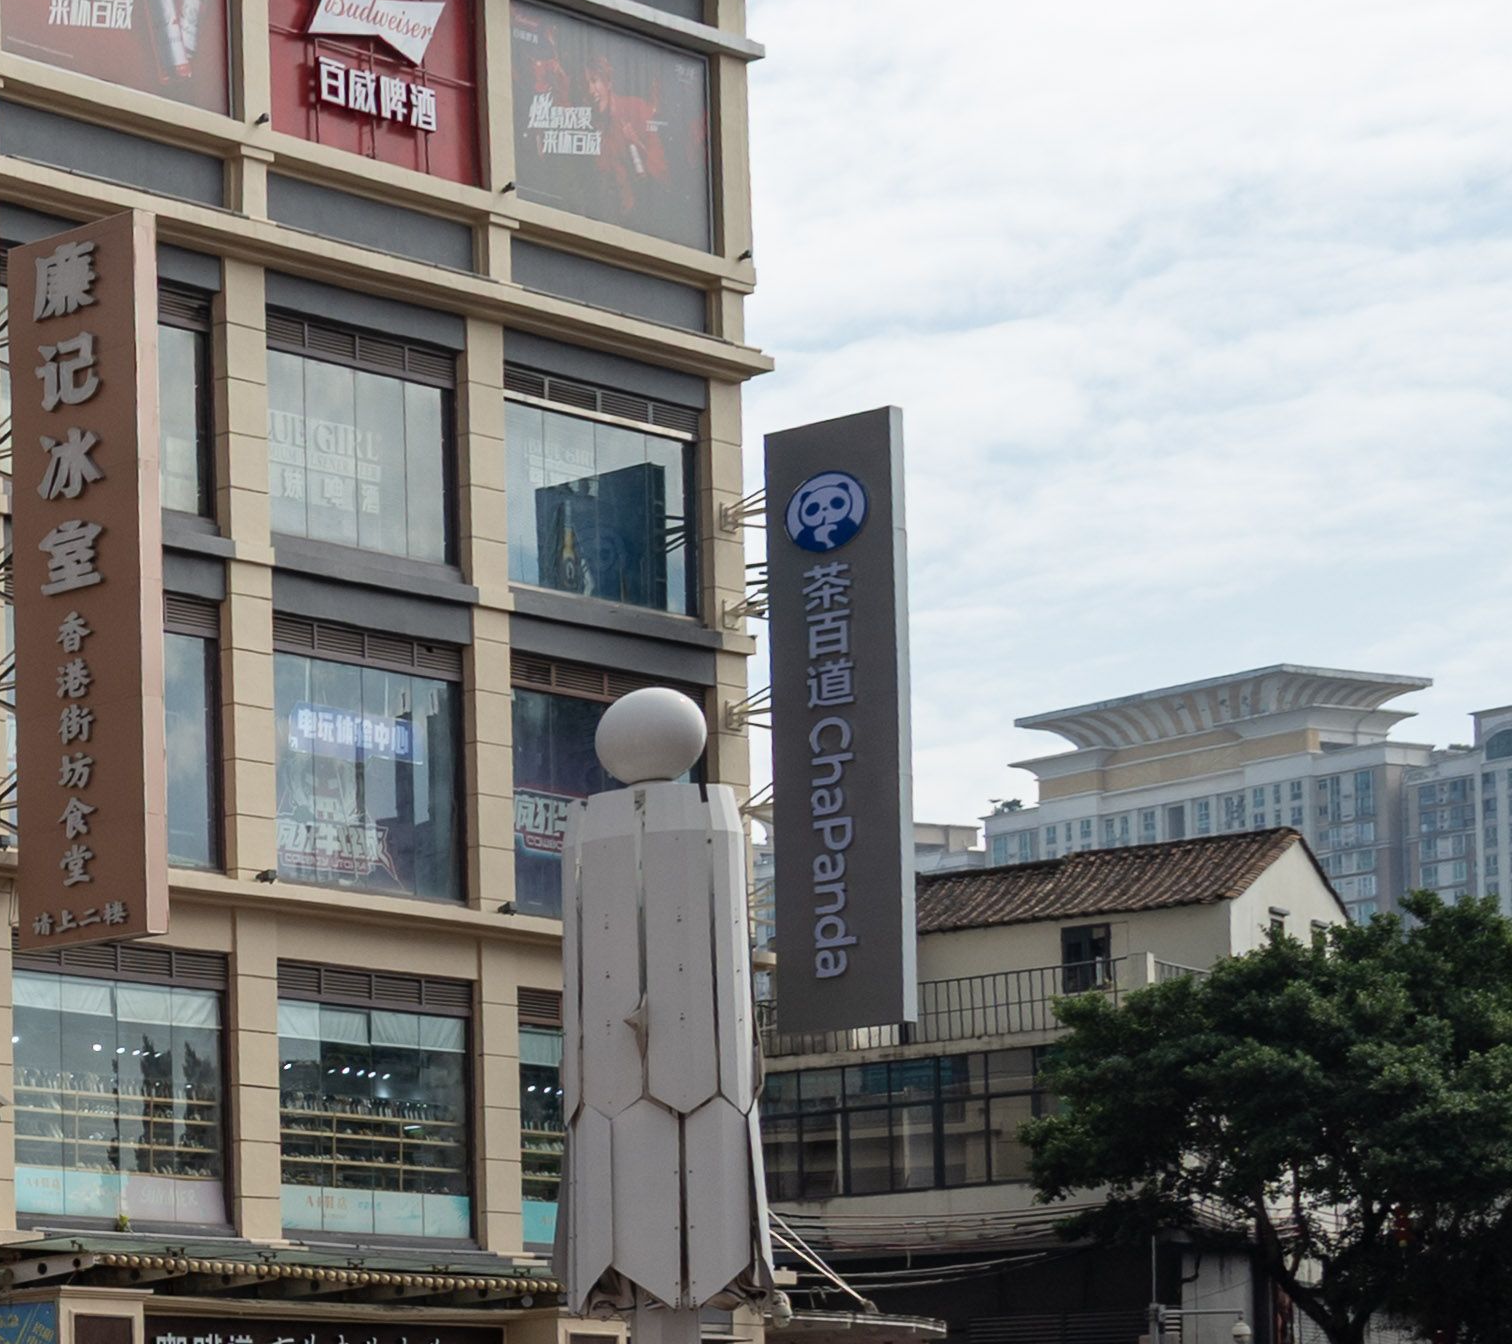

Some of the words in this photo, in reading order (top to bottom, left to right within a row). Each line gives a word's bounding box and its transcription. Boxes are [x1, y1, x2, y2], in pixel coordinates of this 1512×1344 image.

[316, 56, 437, 133] 百威啤酒
[541, 130, 602, 156] 来杯百威
[32, 239, 105, 596] 廉记冰室
[803, 560, 854, 710] 茶百道
[56, 610, 98, 888] 香港街坊食堂
[31, 900, 128, 939] 请上二楼
[809, 714, 859, 980] ChaPanda
